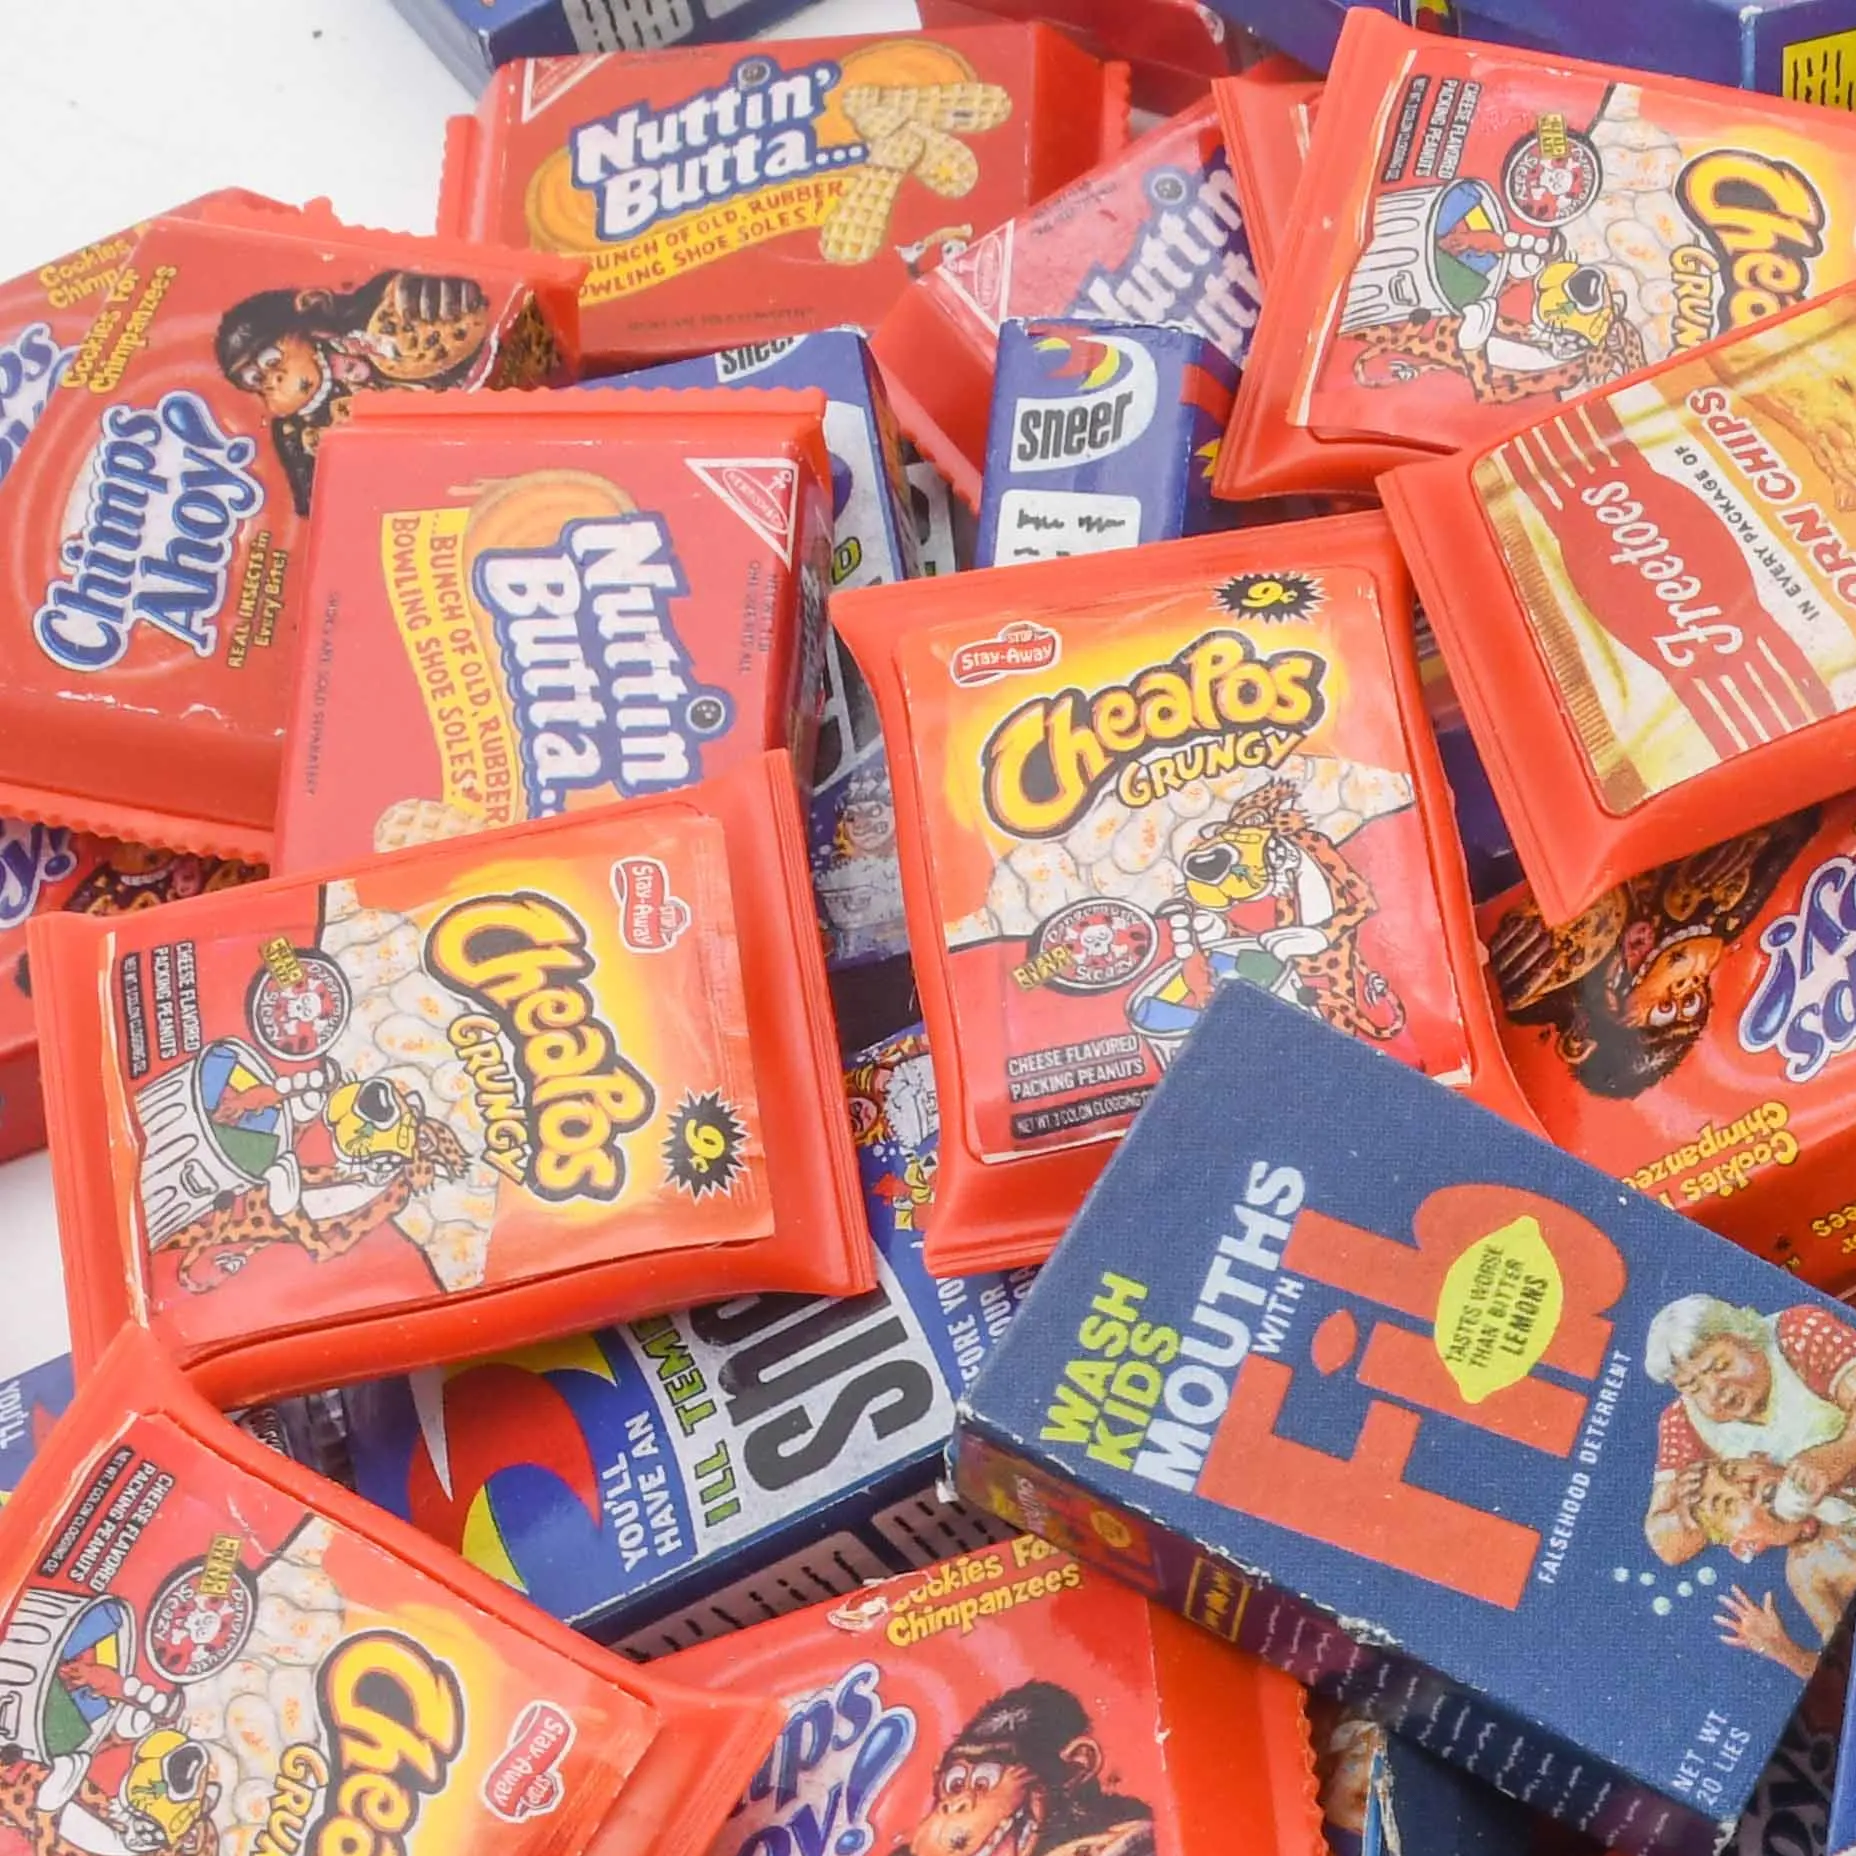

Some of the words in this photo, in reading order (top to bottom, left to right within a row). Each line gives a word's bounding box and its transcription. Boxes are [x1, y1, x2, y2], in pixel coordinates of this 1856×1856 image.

[576, 62, 831, 183] Nuttin'
[673, 234, 729, 267] SHOE
[89, 265, 178, 394] Chimpanzees
[1017, 388, 1134, 463] sneer
[1690, 390, 1797, 503] CHIPS
[38, 407, 162, 668] Chimps
[132, 393, 257, 652] Ahoy!
[1693, 462, 1769, 547] PACKAGE
[391, 514, 428, 632] BOWLING
[413, 636, 455, 704] SHOE
[1752, 546, 1804, 601] EVERY
[1797, 600, 1821, 623] IN
[476, 717, 512, 824] RUBBER
[1117, 731, 1308, 808] GRUNGY
[1008, 1050, 1063, 1077] CHEESE
[1066, 1034, 1139, 1064] FLAVORED
[1011, 1072, 1075, 1101] PACKING
[1077, 1058, 1145, 1087] PEANUTS
[446, 1013, 531, 1186] GRUNGY
[1685, 1131, 1798, 1204] Cookies
[1132, 1160, 1306, 1493] MOUTHS
[1248, 1276, 1305, 1356] WITH
[1499, 1274, 1549, 1356] LEMONS
[1040, 1271, 1149, 1445] WASH
[1086, 1323, 1180, 1470] KIDS
[626, 1410, 654, 1459] AN
[1538, 1470, 1591, 1584] FALSEHOOD
[1580, 1349, 1630, 1465] DETERRENT
[108, 1461, 156, 1520] PACKING
[136, 1473, 175, 1523] CHEESE
[602, 1450, 638, 1574] YOU'LL
[636, 1460, 685, 1560] HAVE
[692, 1439, 743, 1530] ILL
[67, 1520, 118, 1583] PEANUTS
[88, 1521, 140, 1594] FLAVORED
[885, 1564, 1083, 1647] Chimpanzees
[1671, 1746, 1703, 1794] NET
[1717, 1728, 1751, 1777] LIES
